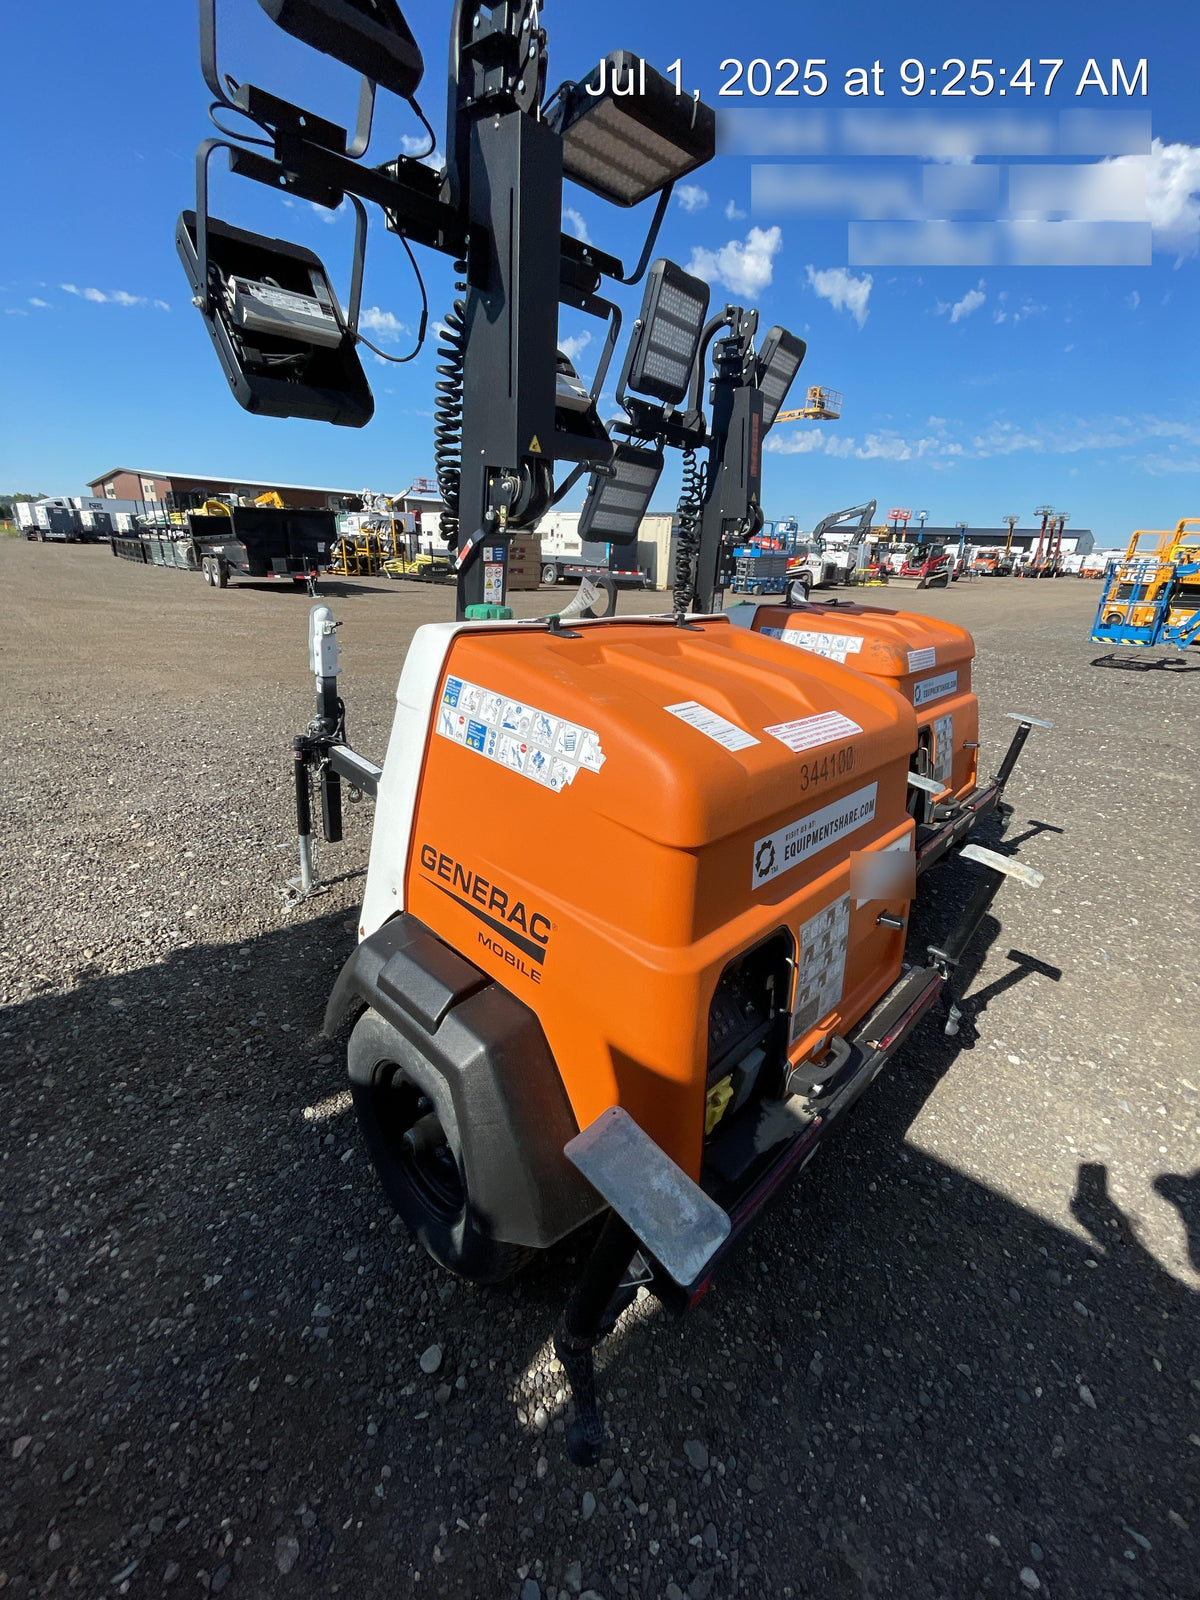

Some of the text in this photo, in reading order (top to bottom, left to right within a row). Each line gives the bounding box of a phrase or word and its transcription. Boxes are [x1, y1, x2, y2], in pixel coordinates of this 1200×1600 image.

[1120, 573, 1156, 583] JCB
[800, 746, 854, 791] 344100
[784, 799, 875, 861] EQUIPMENTSHARE.COM
[420, 844, 551, 944] GENERAC
[478, 932, 542, 984] MOBILE
